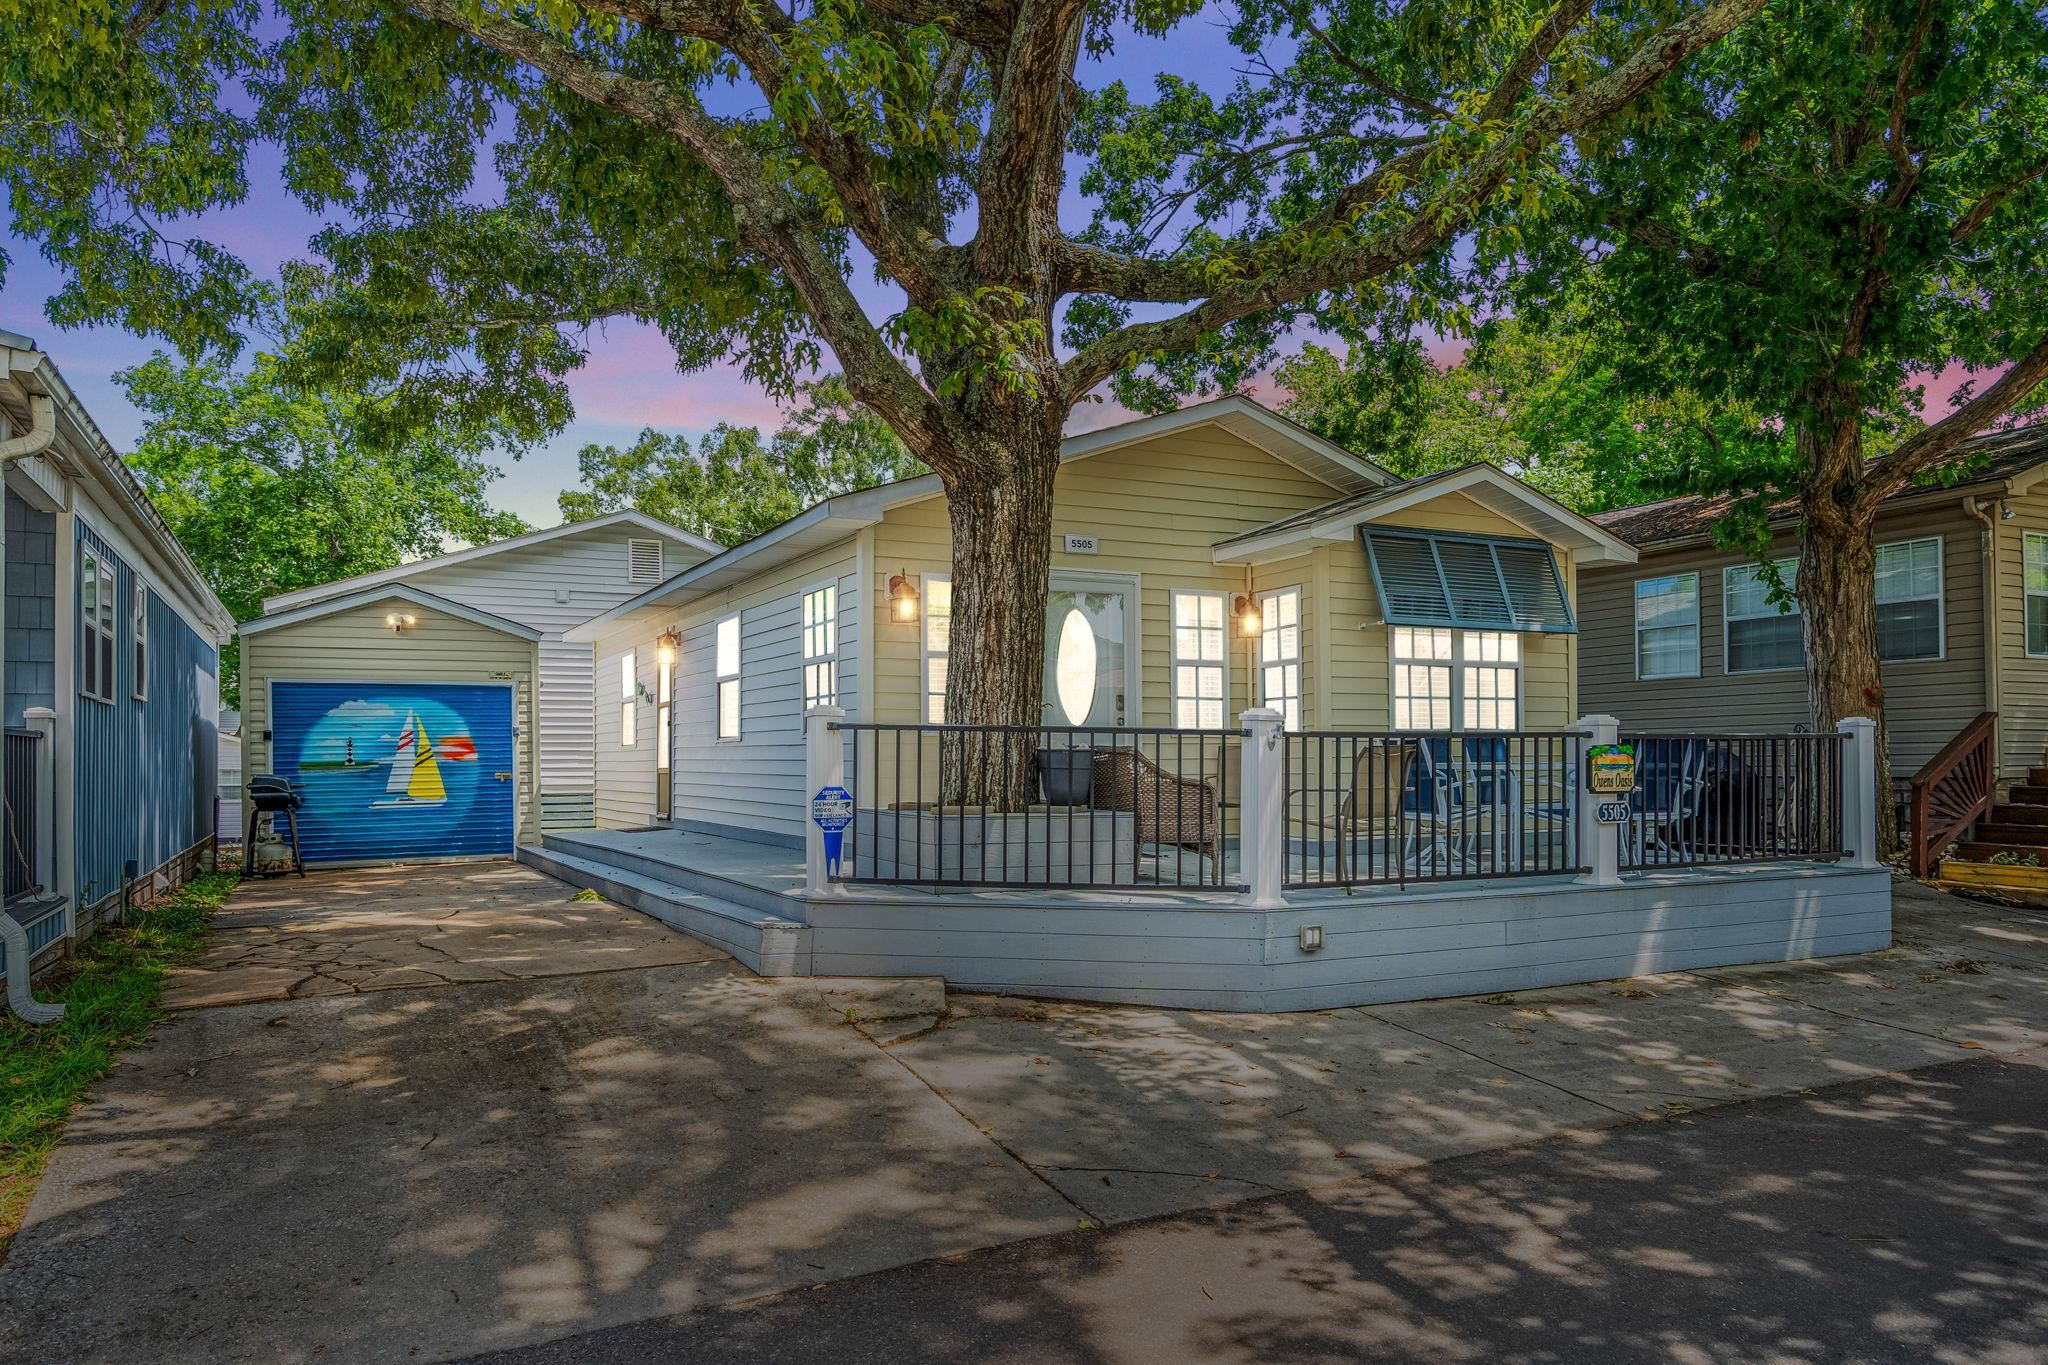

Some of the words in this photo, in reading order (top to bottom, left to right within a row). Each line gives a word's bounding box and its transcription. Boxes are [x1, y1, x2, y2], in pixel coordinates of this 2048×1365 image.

[1072, 540, 1092, 548] 5505
[1594, 772, 1614, 788] Owens
[1616, 772, 1632, 788] Oasis
[1602, 804, 1626, 821] 5505
